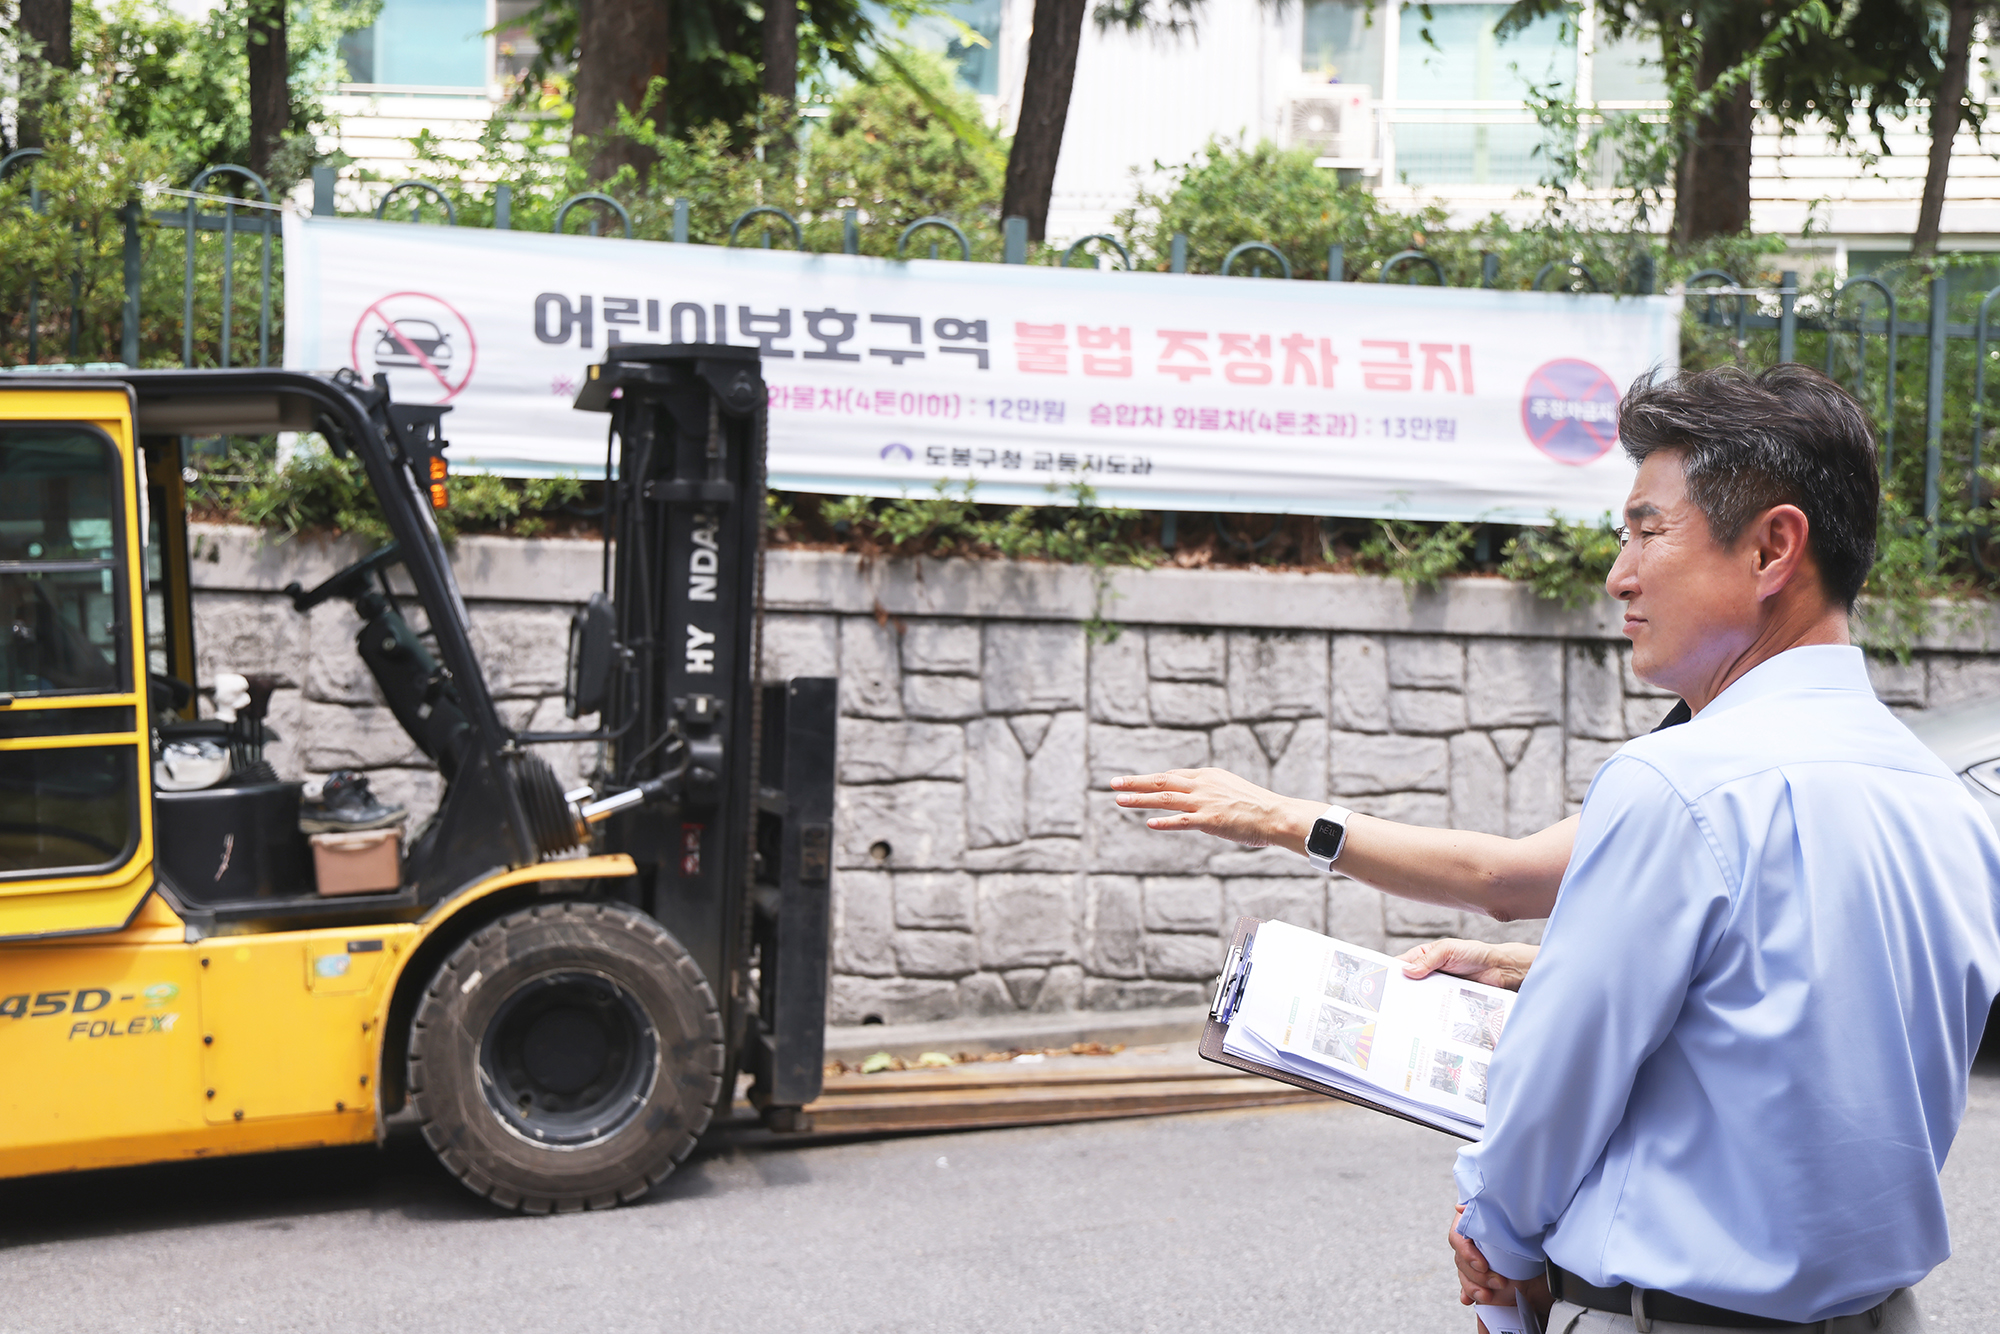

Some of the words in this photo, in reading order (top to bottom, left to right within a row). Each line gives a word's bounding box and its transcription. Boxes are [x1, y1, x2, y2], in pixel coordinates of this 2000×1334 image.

[533, 292, 990, 370] 어린이보호구역
[1014, 321, 1132, 378] 불법
[1156, 328, 1339, 390] 주정차
[1360, 339, 1475, 395] 금지
[985, 398, 1066, 424] 12만원
[1381, 416, 1457, 442] 13만원
[926, 445, 1021, 470] 도봉구청
[1033, 451, 1153, 475] 교통지도과
